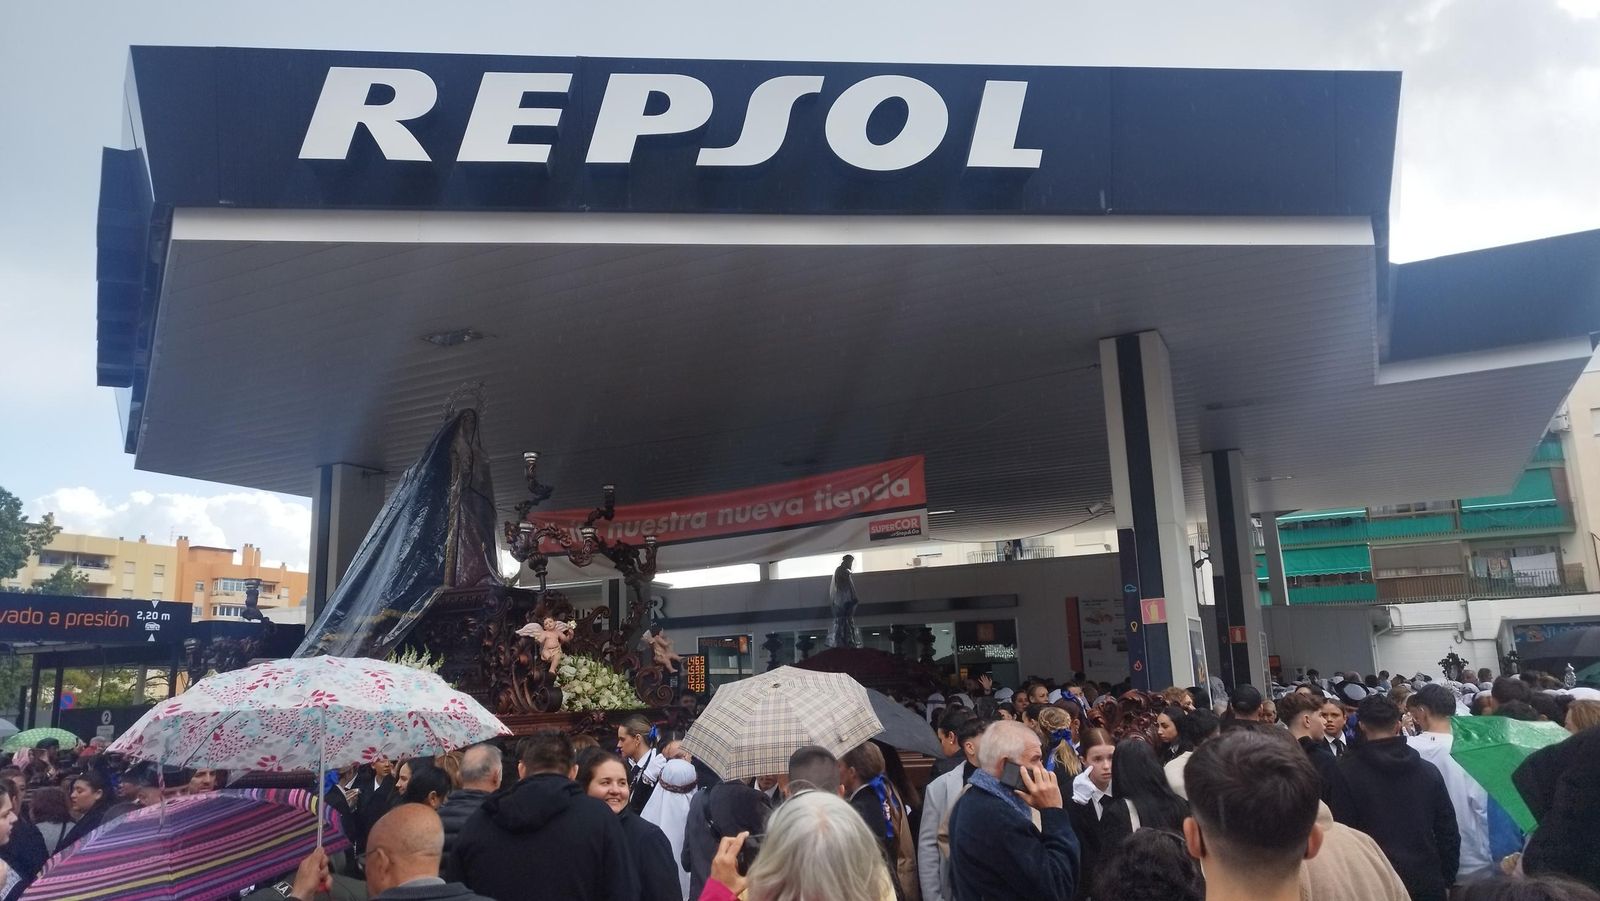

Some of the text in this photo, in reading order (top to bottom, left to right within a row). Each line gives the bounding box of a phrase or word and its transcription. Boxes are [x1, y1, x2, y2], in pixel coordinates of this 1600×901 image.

[298, 66, 1043, 171] REPSOL
[607, 511, 707, 540] nuestra
[717, 497, 804, 527] nueva
[814, 473, 910, 512] tienda
[871, 518, 919, 534] SUPERCOR
[50, 611, 60, 625] a
[65, 609, 130, 629] presión
[137, 610, 170, 621] 2,20 m
[104, 712, 110, 722] 2
